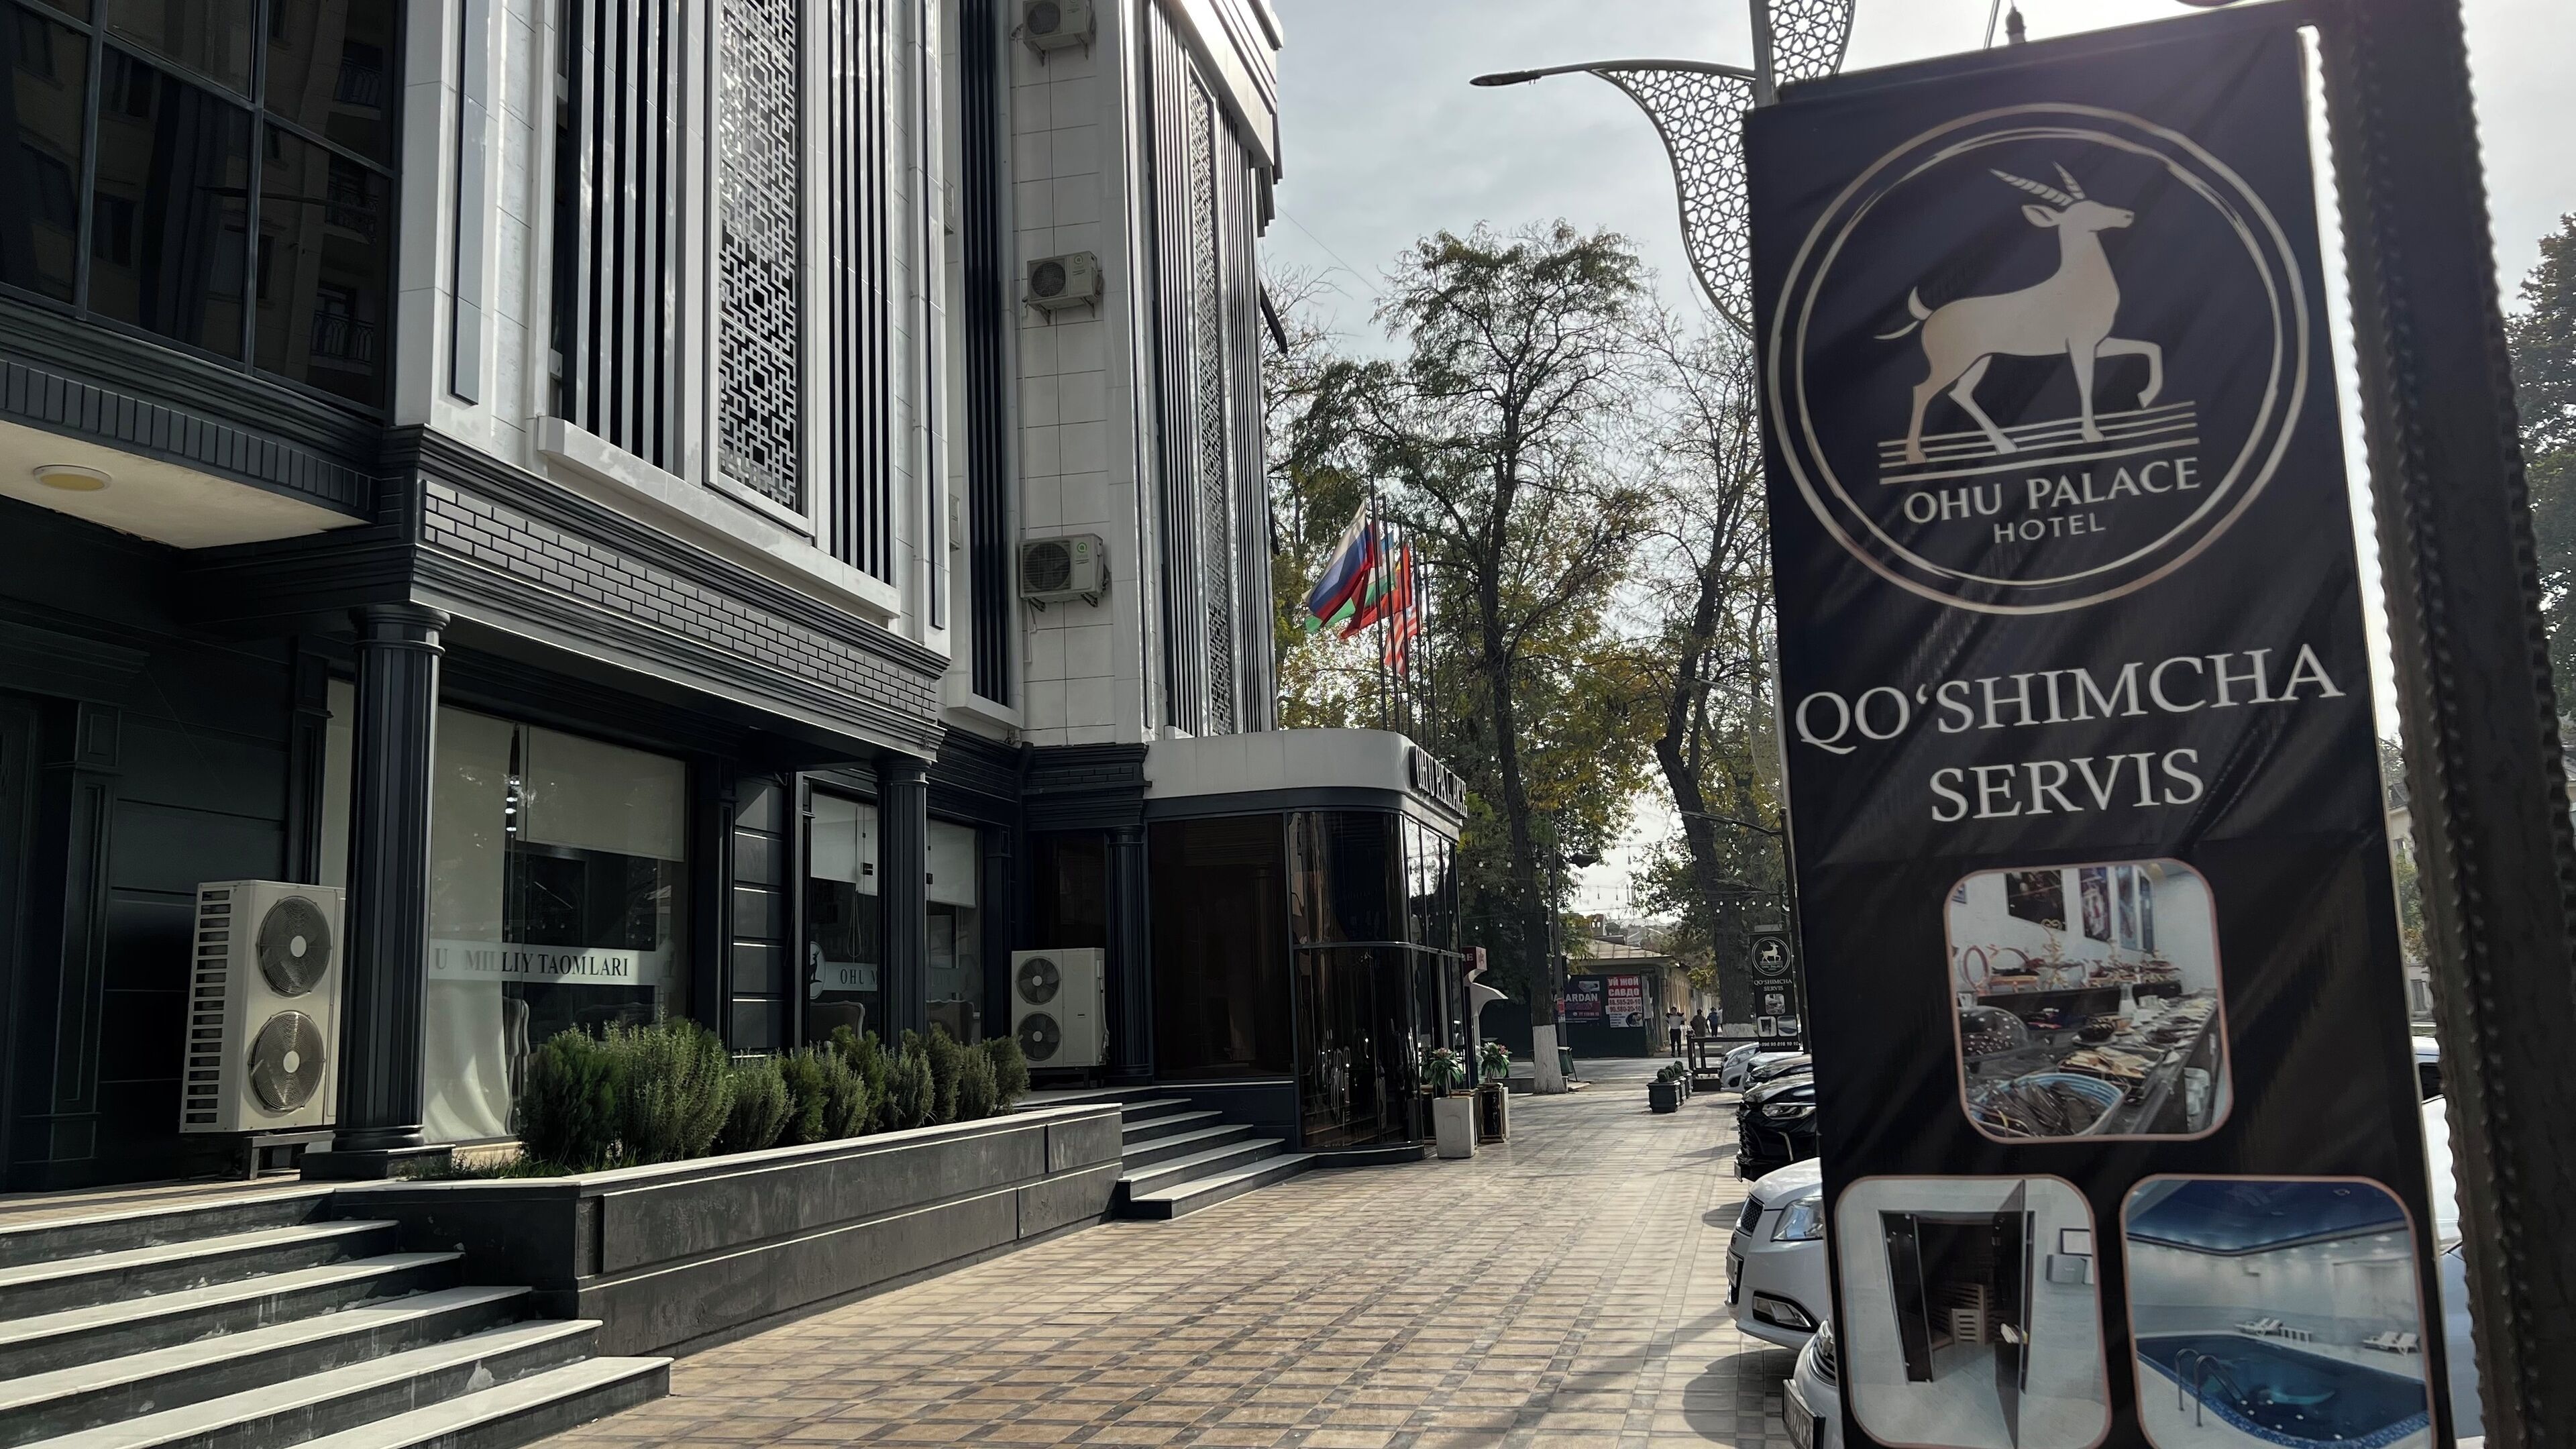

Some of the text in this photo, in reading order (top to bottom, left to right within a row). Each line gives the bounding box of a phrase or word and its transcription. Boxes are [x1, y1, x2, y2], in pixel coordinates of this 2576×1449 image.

[1904, 456, 2201, 524] OHU PALACE
[1993, 512, 2106, 544] HOTEL
[1415, 745, 1468, 818] OHU PALACE
[1929, 747, 2204, 822] SERVIS
[465, 949, 535, 973] MILLIY
[840, 968, 865, 985] OHU
[1608, 987, 1640, 997] САВДО
